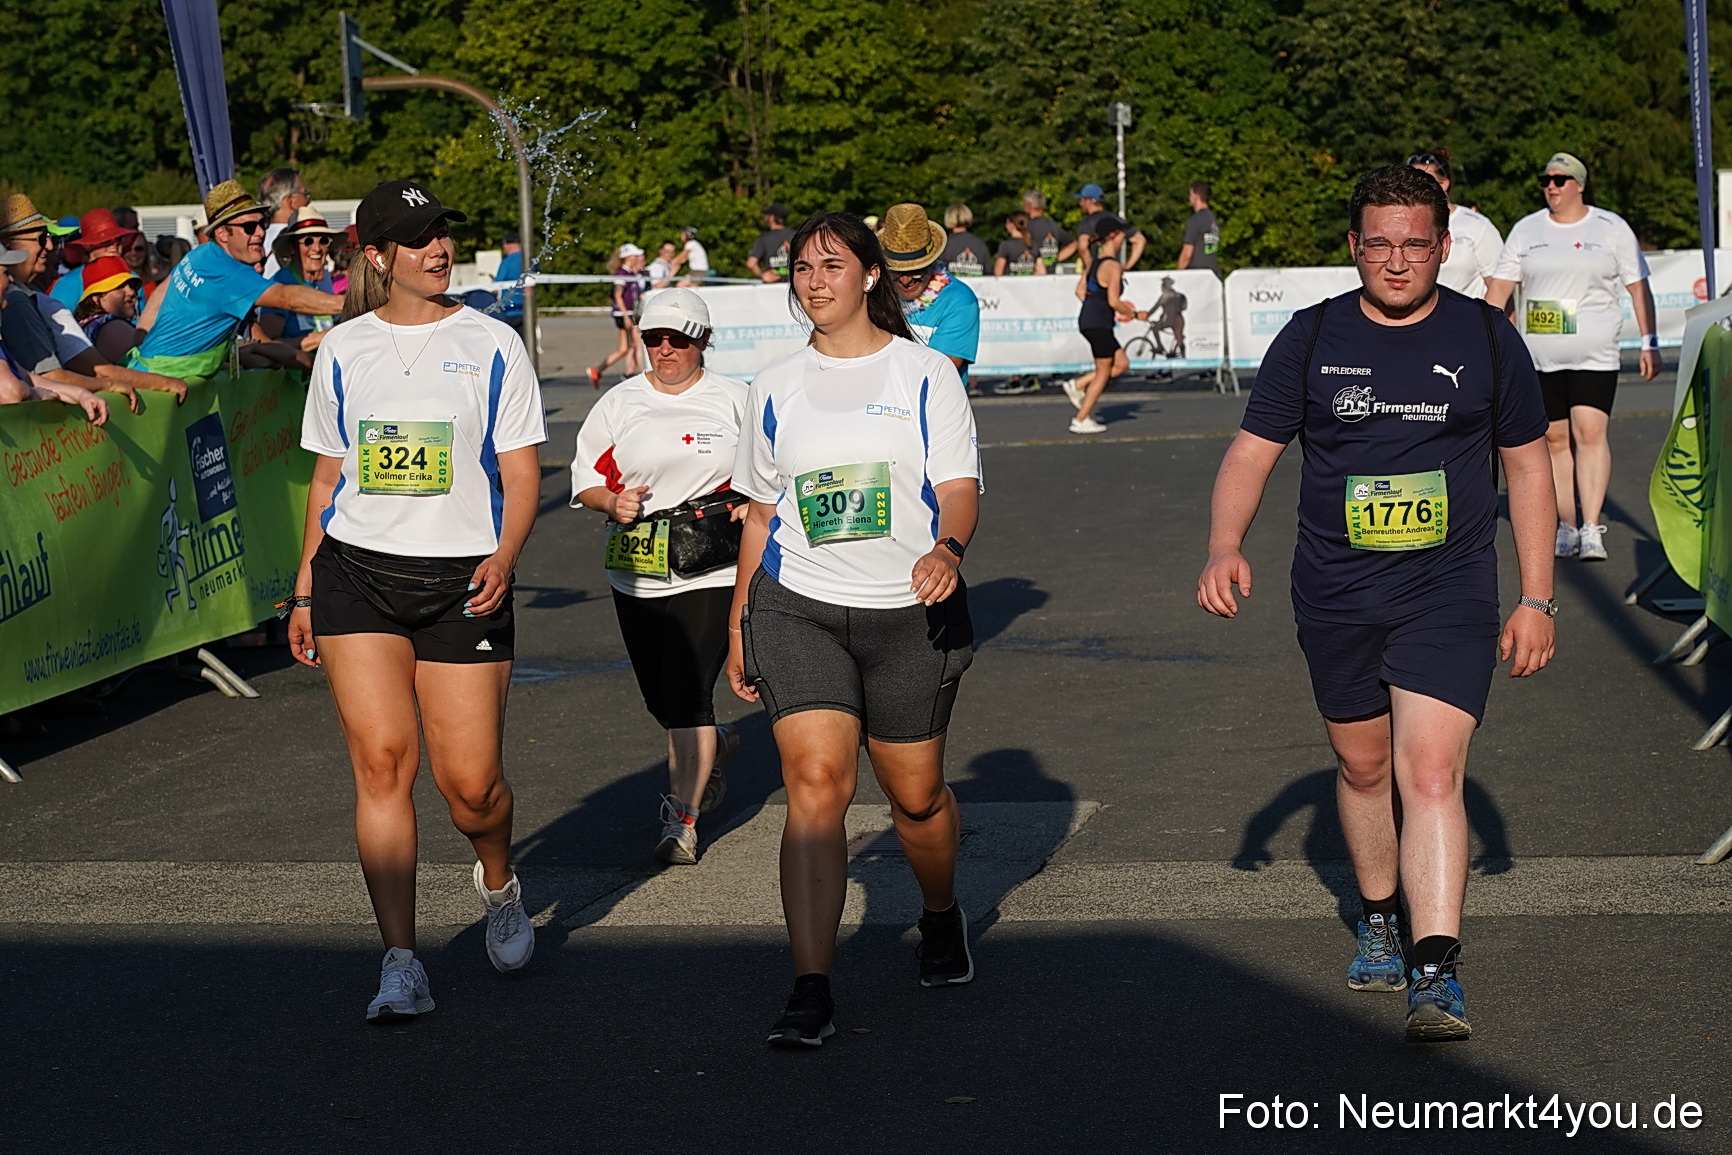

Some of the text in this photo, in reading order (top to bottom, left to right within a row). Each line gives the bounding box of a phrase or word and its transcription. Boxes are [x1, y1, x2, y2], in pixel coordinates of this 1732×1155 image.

[1249, 291, 1283, 304] NOW
[1531, 311, 1556, 324] 1492
[458, 363, 481, 373] PETTER
[1328, 366, 1373, 376] PFLEIDERER
[883, 405, 911, 416] PETTER
[1373, 402, 1449, 414] Firmenlauf
[1402, 413, 1446, 422] neumarkt
[4, 427, 62, 487] Gesunde
[195, 445, 225, 472] Fischer
[378, 446, 428, 470] 324
[374, 472, 433, 481] Vollmer Erika
[438, 451, 447, 484] 2022
[44, 474, 93, 524] laufen
[1370, 488, 1403, 497] Firmenlauf
[815, 488, 866, 518] 309
[876, 491, 886, 526] 2022
[1363, 499, 1433, 527] 1776
[1434, 501, 1443, 536] 2022
[813, 515, 872, 530] Hiereth Elena
[1351, 505, 1362, 540] WALK
[1361, 525, 1435, 536] Bernreuther Andreas
[620, 534, 652, 556] 929
